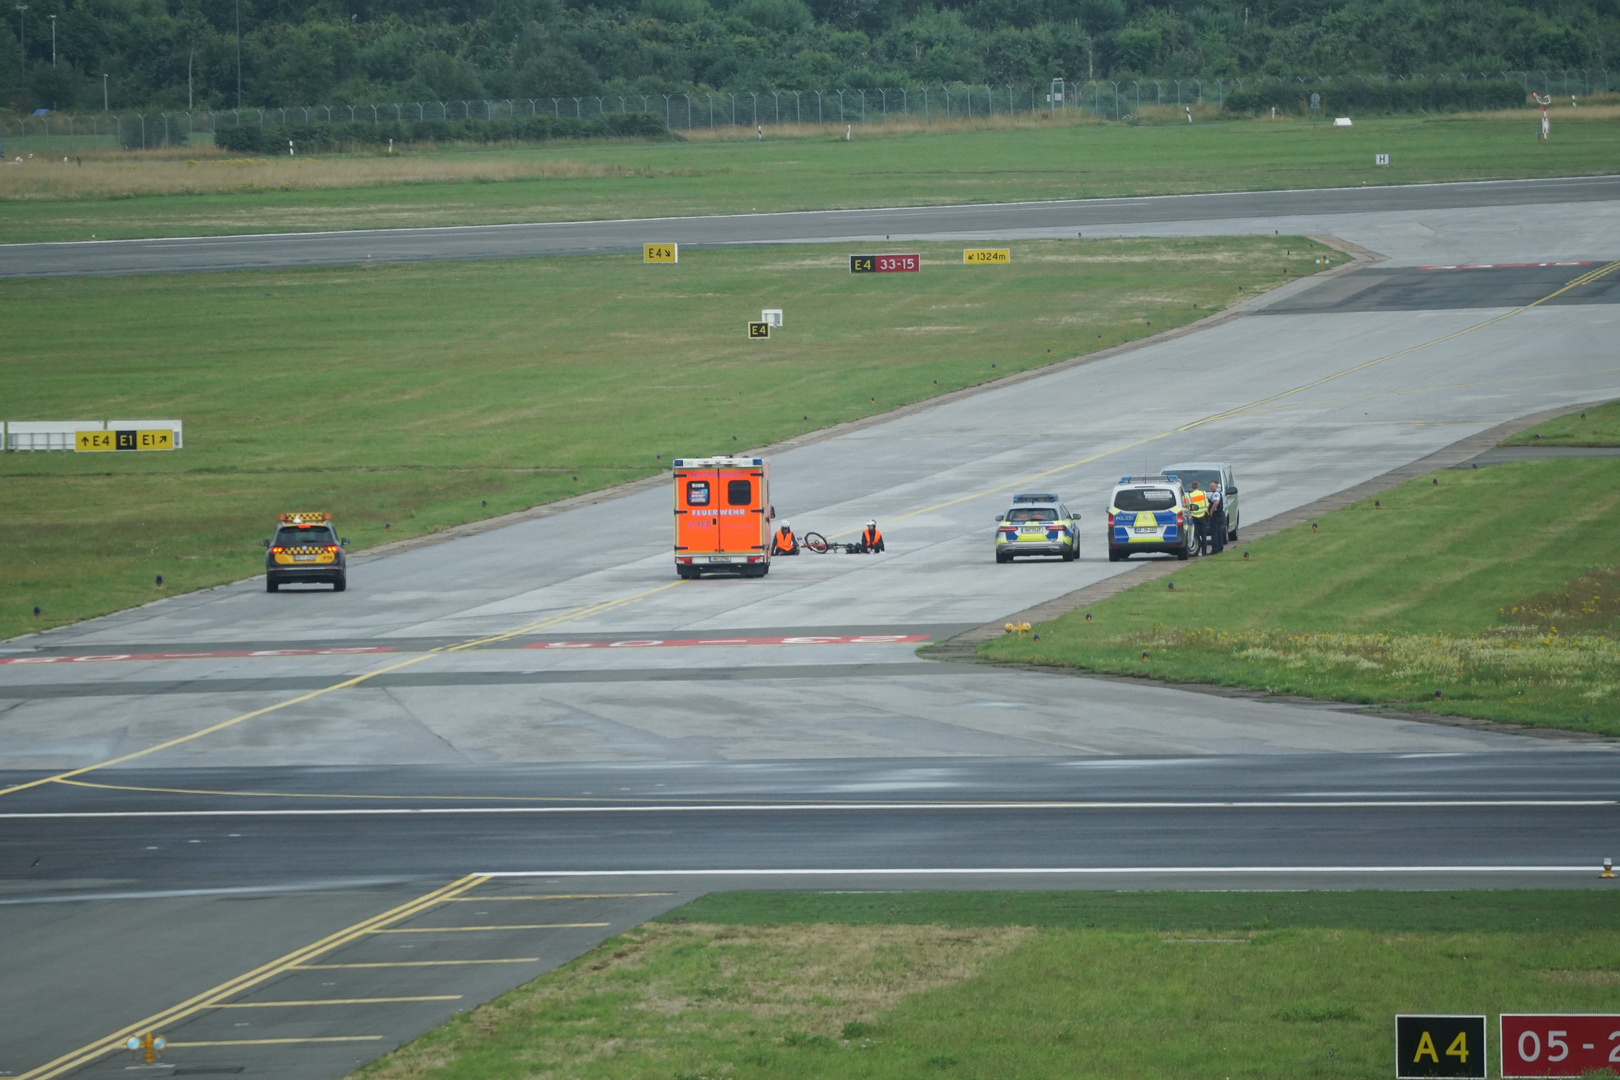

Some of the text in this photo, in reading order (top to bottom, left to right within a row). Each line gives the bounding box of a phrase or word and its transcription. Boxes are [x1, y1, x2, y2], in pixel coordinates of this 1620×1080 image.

[648, 247, 662, 258] E4
[976, 251, 1006, 261] 1324m
[855, 258, 915, 271] E4 33-15
[752, 325, 766, 335] E4
[93, 434, 155, 446] E4 E1 E1
[1413, 1031, 1469, 1063] A4
